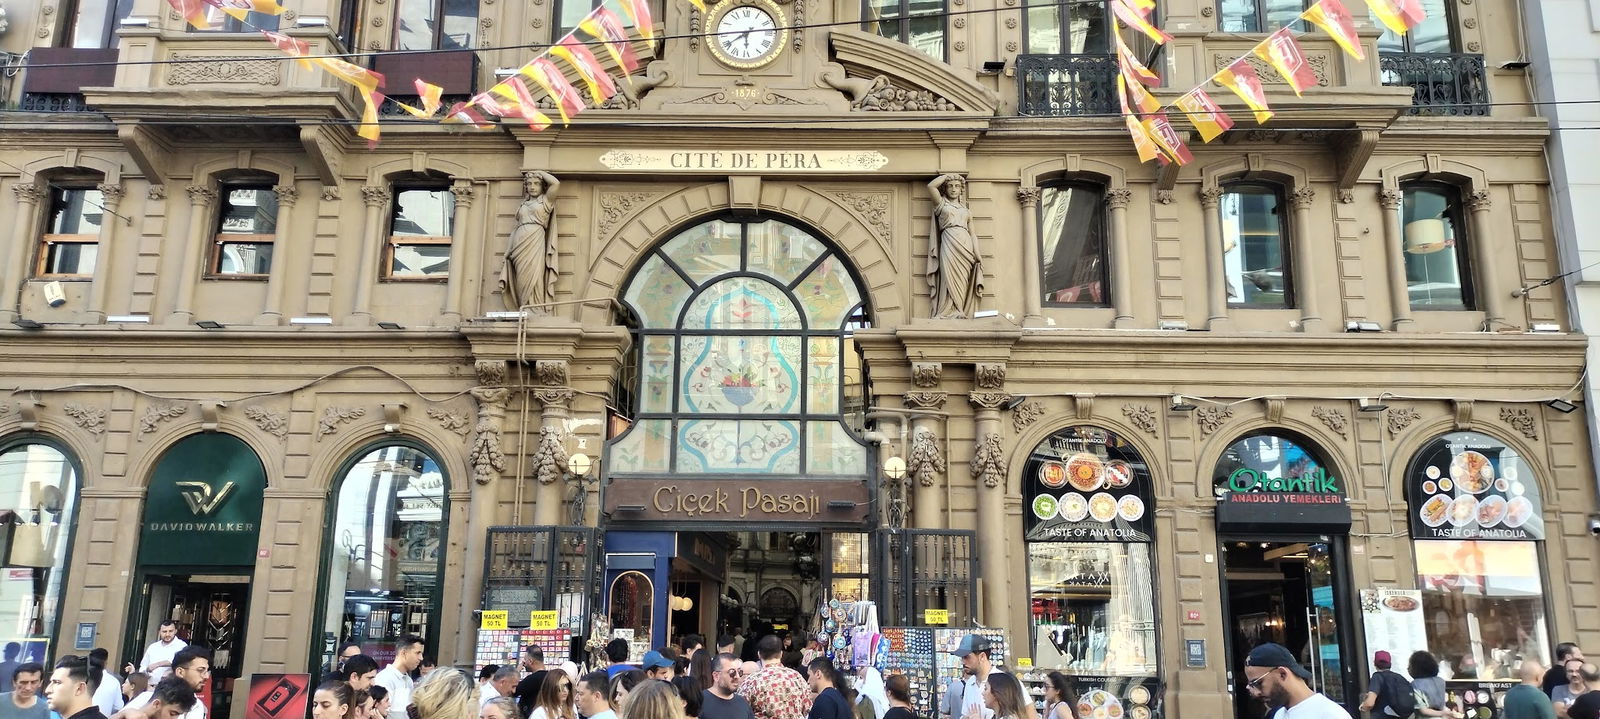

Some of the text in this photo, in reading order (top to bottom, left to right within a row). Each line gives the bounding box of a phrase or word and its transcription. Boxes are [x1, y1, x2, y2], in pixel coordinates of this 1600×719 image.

[734, 88, 756, 98] 1876
[670, 151, 822, 169] CITÉ DE PÉRA
[1228, 467, 1338, 492] Otantik
[1231, 494, 1280, 503] ANADOLU
[1043, 529, 1137, 537] TASTE OF ANATOLIA
[1432, 528, 1527, 538] TASTE OF ANATOLIA
